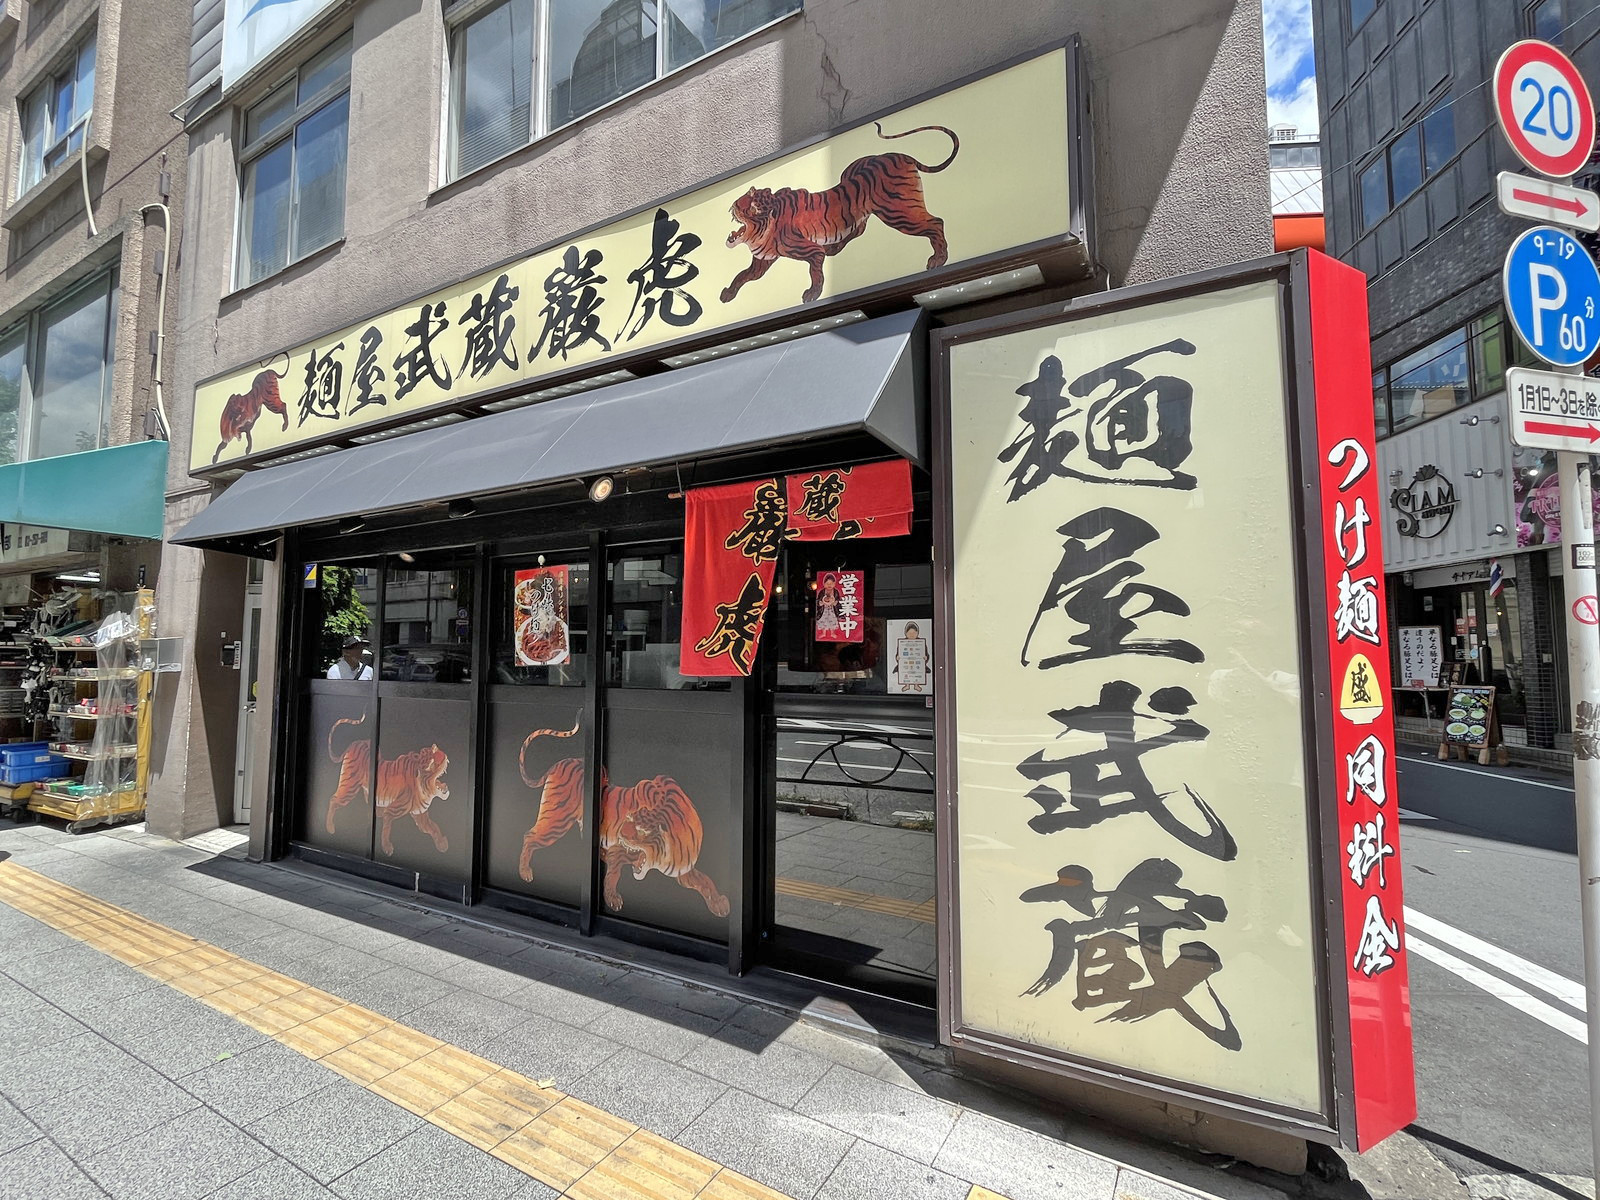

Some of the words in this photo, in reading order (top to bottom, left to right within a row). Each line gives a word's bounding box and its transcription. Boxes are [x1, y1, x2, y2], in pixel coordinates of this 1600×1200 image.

[1519, 77, 1574, 142] 20
[1533, 235, 1575, 260] 9-19
[1529, 262, 1567, 347] P
[1518, 383, 1600, 418] 1月1日～3日を除
[1328, 438, 1381, 647] つけ麺
[1389, 484, 1457, 537] SIAM
[838, 573, 860, 639] 営業中
[997, 338, 1242, 1051] 麺屋武蔵
